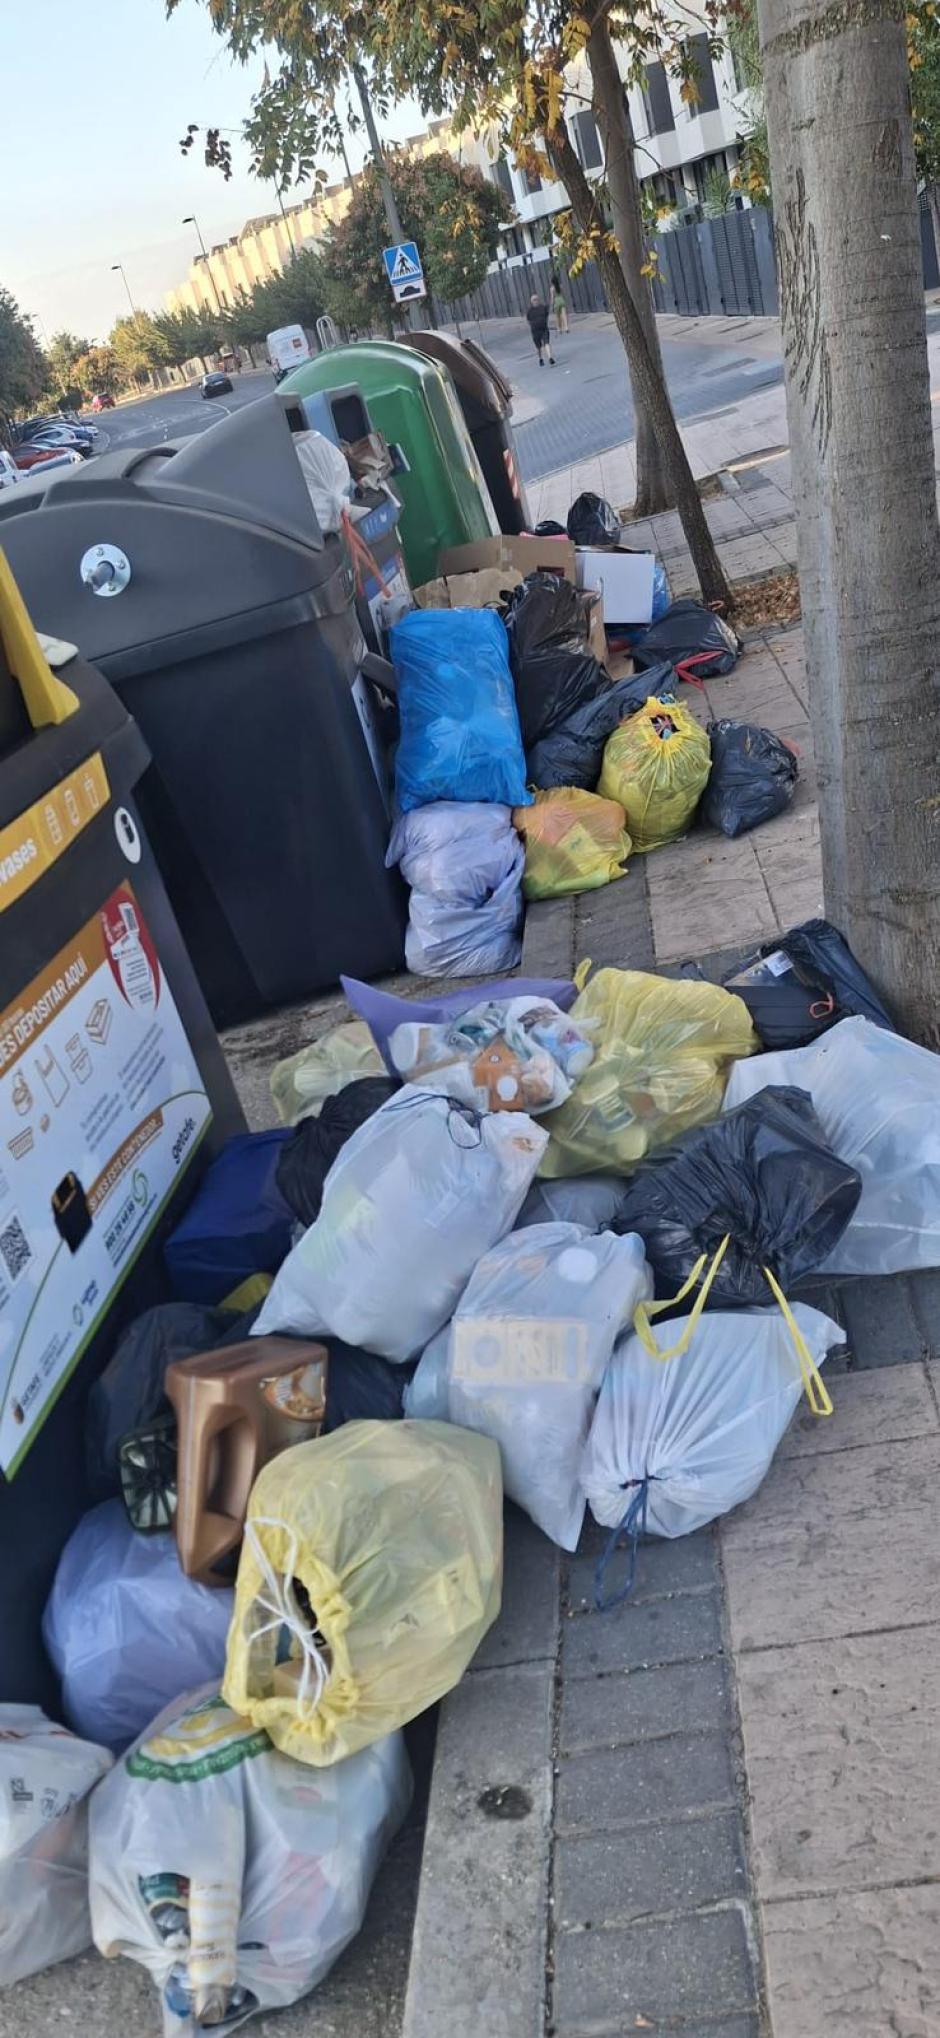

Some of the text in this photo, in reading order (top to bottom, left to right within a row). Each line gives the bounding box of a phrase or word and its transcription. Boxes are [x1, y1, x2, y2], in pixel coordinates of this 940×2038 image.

[13, 979, 68, 1045] DEPOSITAR
[64, 951, 88, 990] AQUÍ
[172, 1117, 197, 1165] getafe
